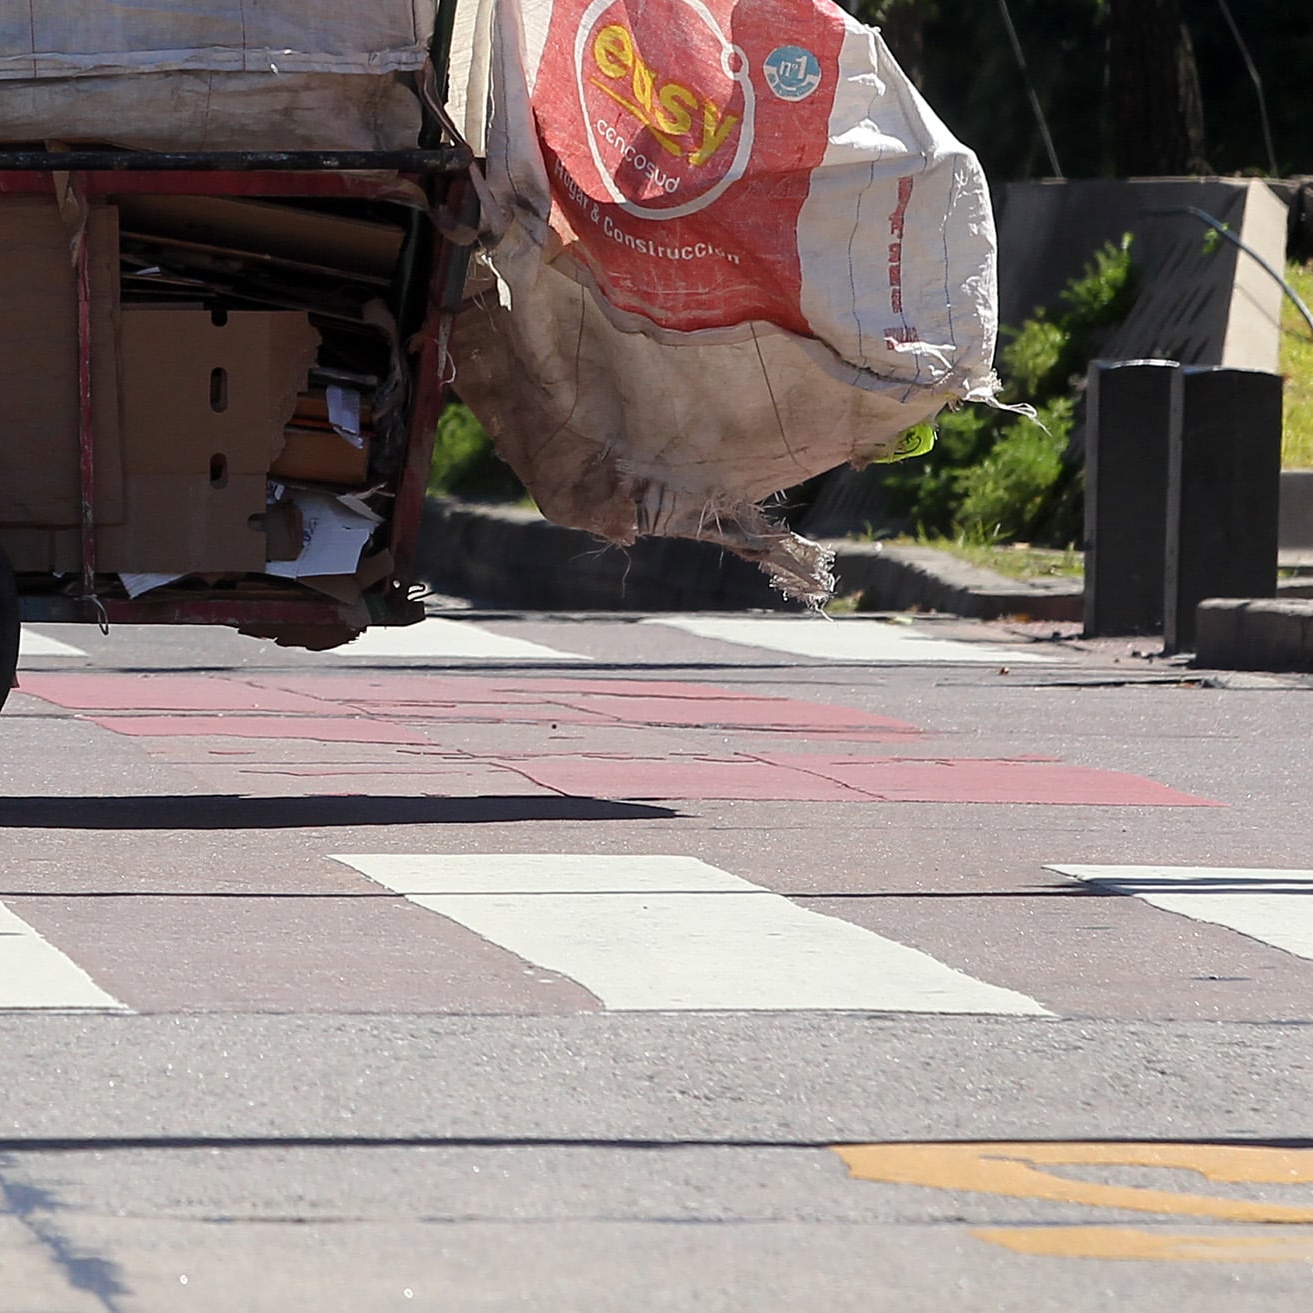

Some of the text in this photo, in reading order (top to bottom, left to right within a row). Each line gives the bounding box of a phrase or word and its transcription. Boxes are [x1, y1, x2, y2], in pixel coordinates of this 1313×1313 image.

[593, 24, 739, 168] easy
[596, 119, 681, 193] cencosud
[590, 205, 600, 225] &
